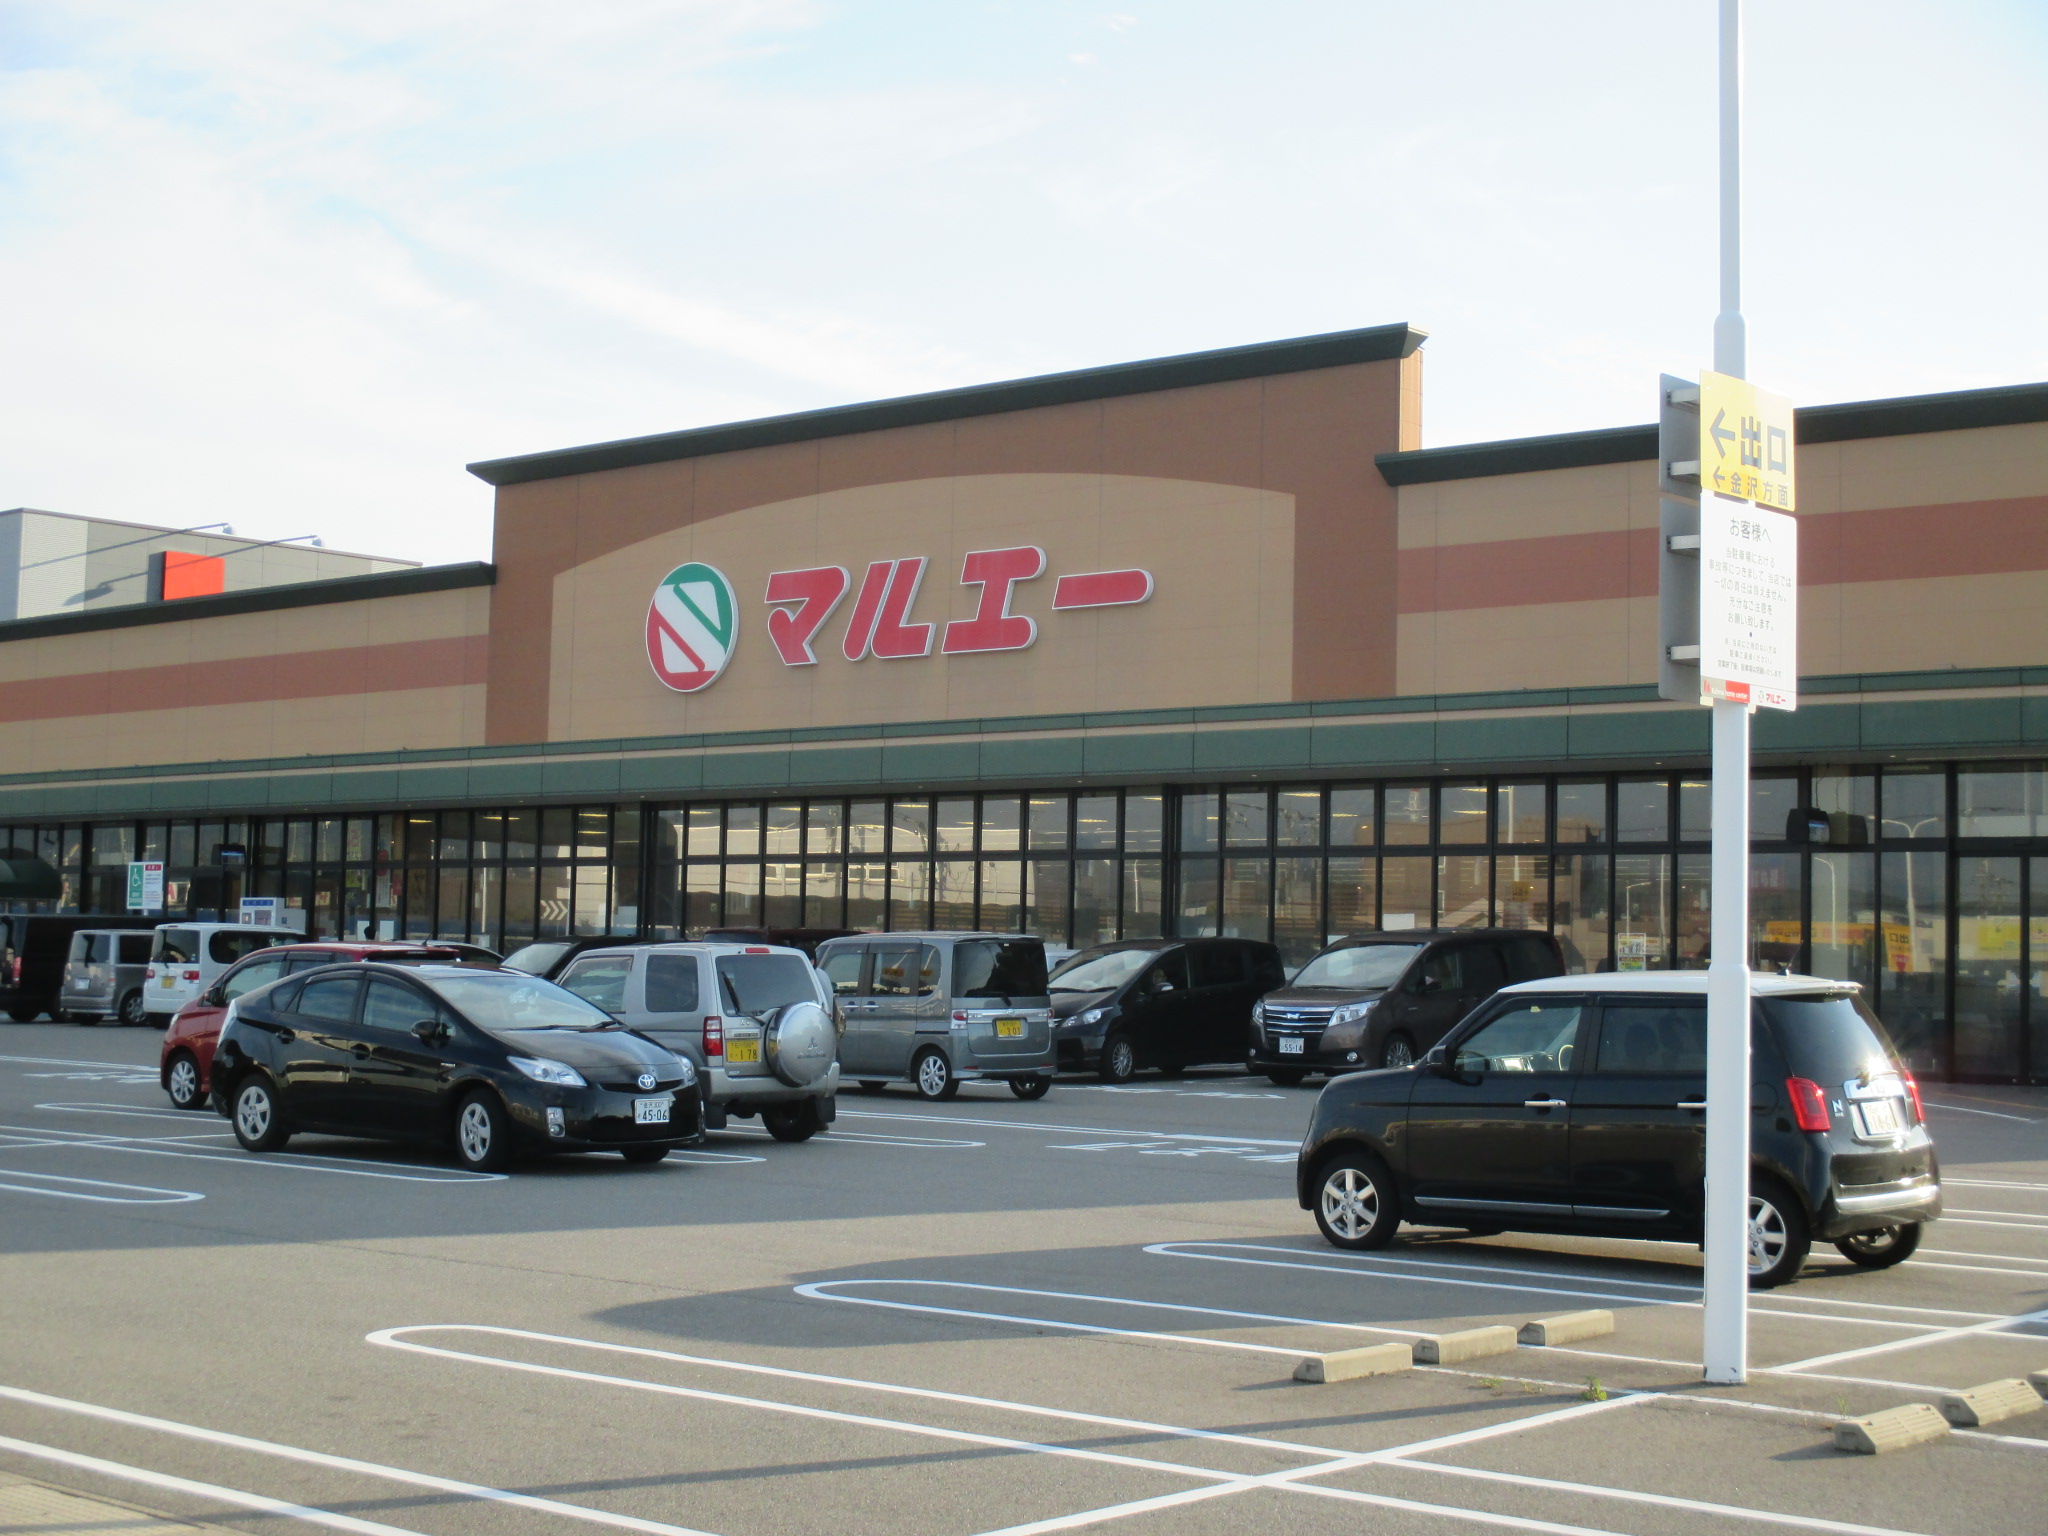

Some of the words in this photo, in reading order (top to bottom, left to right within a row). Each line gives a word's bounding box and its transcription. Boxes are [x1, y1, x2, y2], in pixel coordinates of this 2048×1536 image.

[1741, 415, 1787, 475] 出口
[1730, 471, 1788, 507] 金沢方面
[1730, 517, 1771, 543] お客様へ
[764, 545, 1154, 666] マルエー
[1765, 693, 1787, 704] マルエー
[642, 1109, 668, 1121] 45-06
